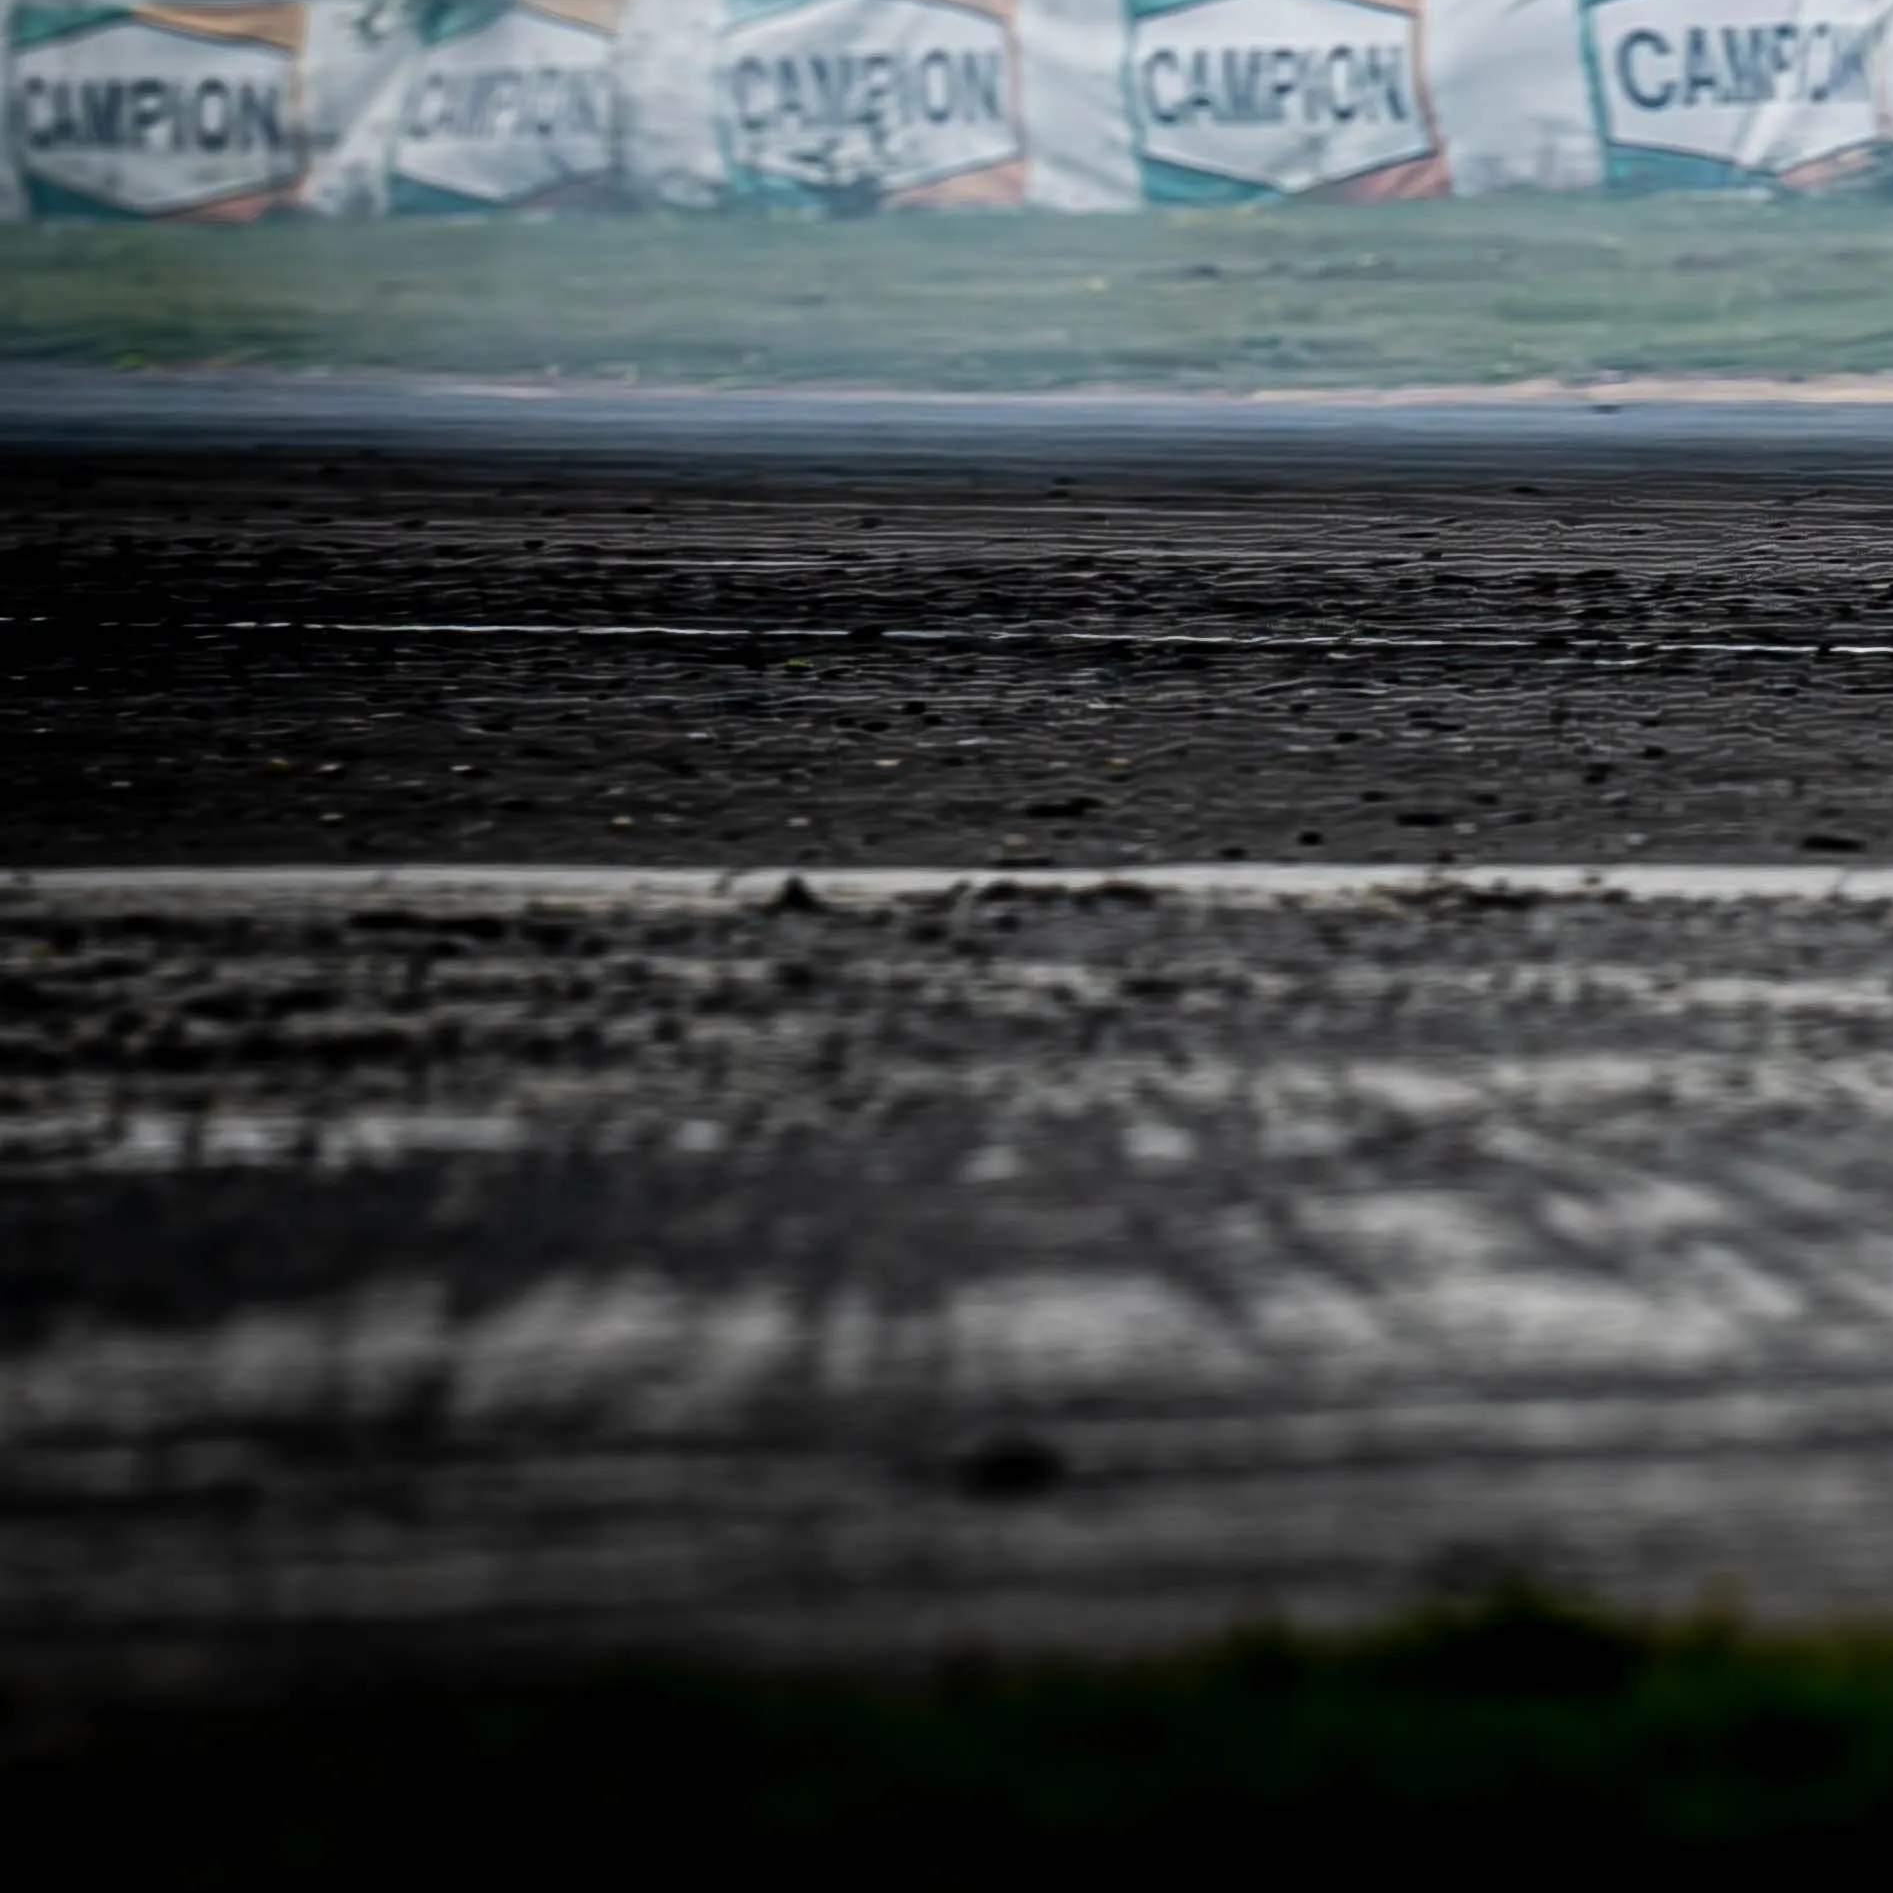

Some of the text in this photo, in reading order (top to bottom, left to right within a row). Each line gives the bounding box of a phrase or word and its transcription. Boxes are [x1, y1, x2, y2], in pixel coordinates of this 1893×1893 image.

[728, 48, 1000, 129] CAMPION
[1143, 46, 1407, 124] CAMPION
[1615, 21, 1868, 111] CAMPON
[20, 76, 283, 151] CAMPION
